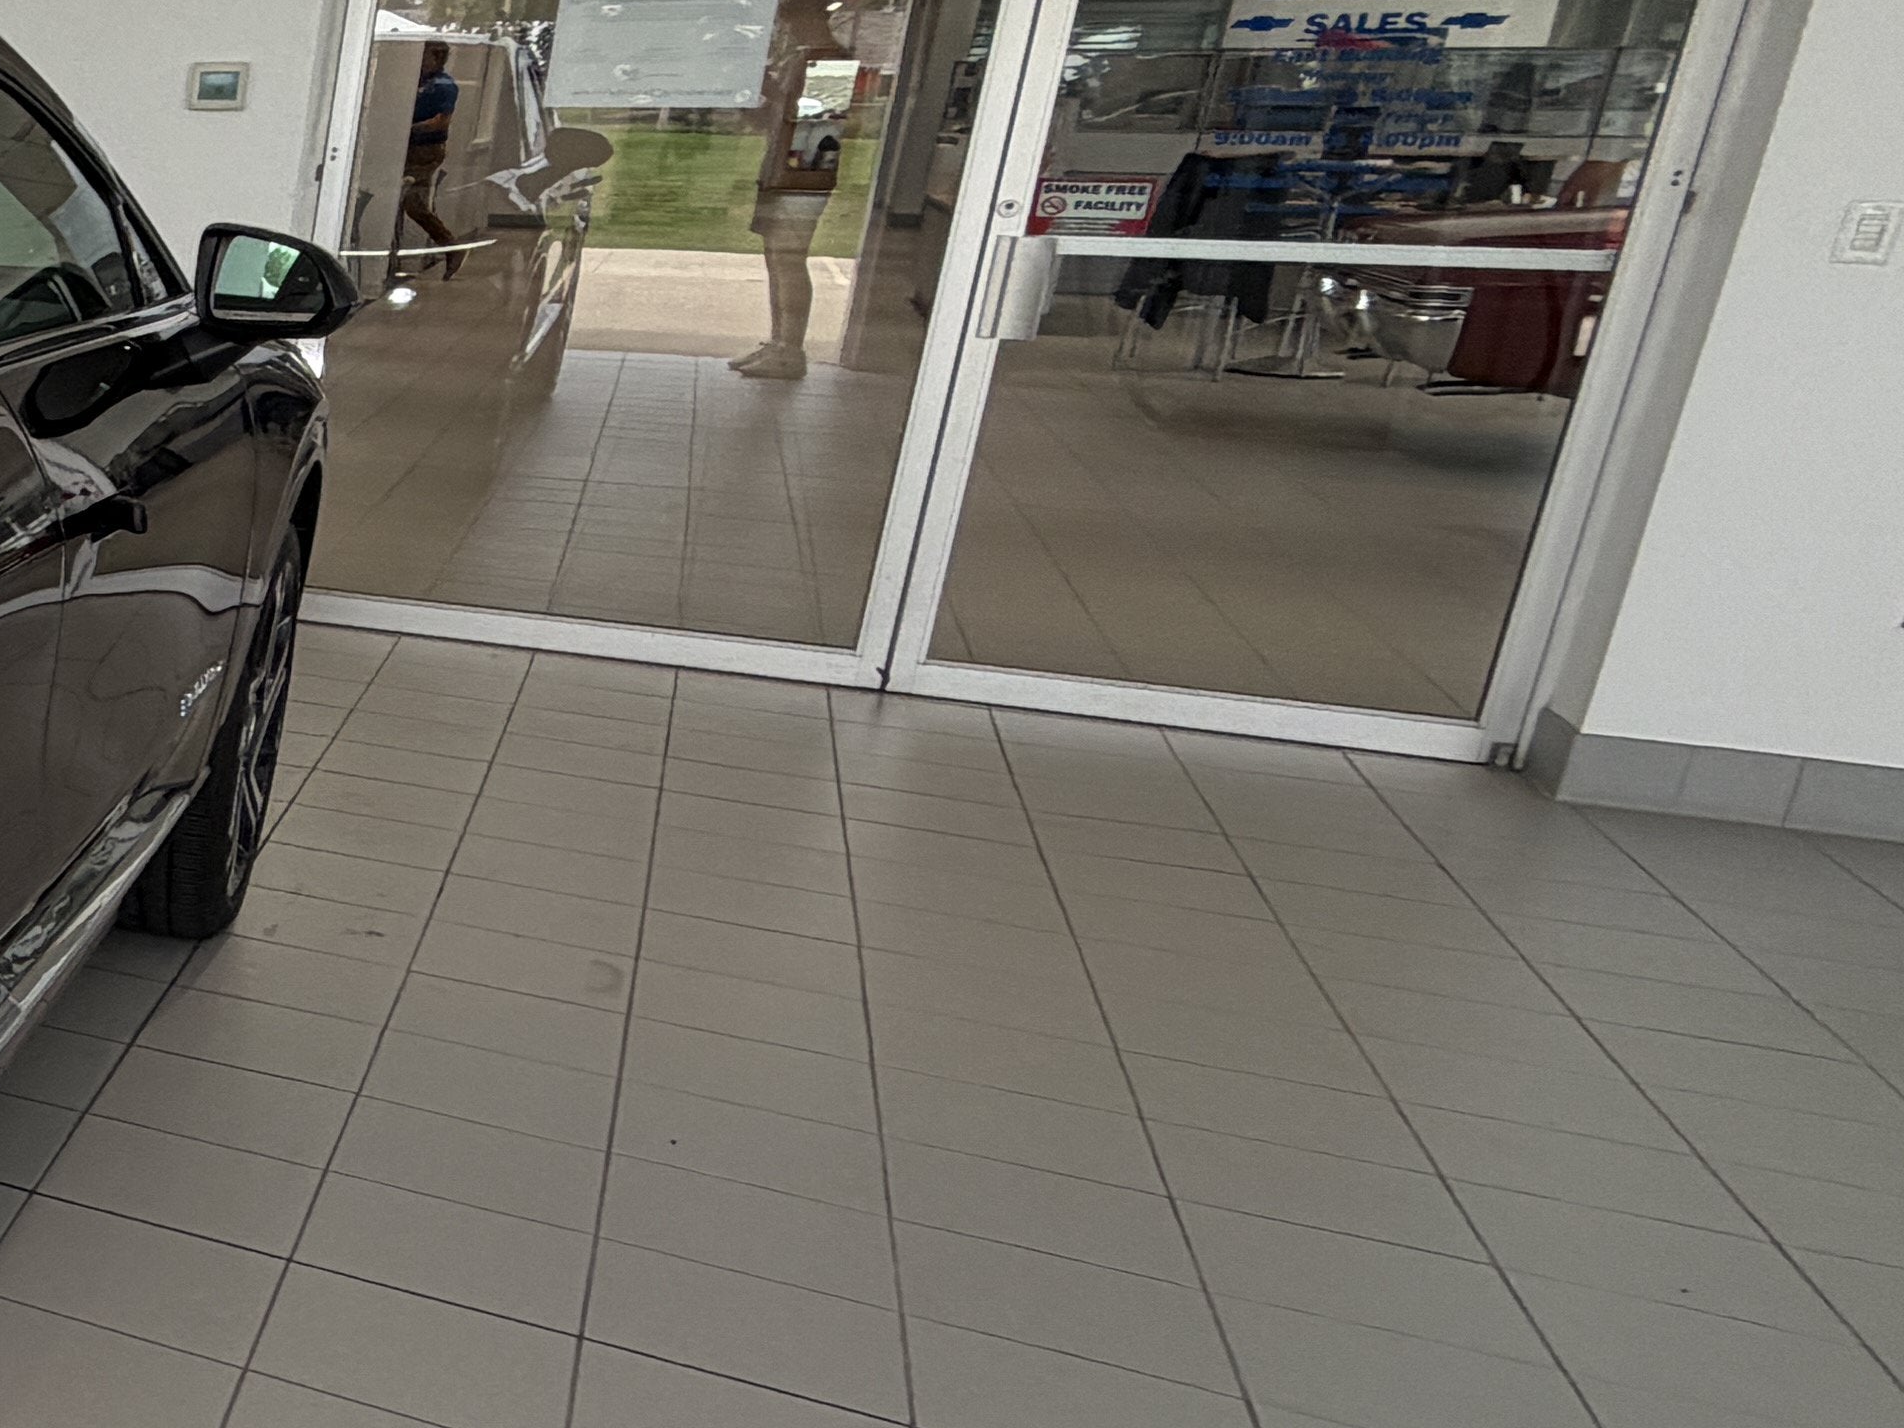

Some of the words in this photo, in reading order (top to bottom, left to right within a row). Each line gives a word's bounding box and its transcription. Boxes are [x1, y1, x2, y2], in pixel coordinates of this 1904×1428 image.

[1303, 11, 1430, 36] SALES
[1044, 183, 1103, 195] SMOKE
[1105, 184, 1148, 196] FREE
[1073, 200, 1145, 212] FACILITY
